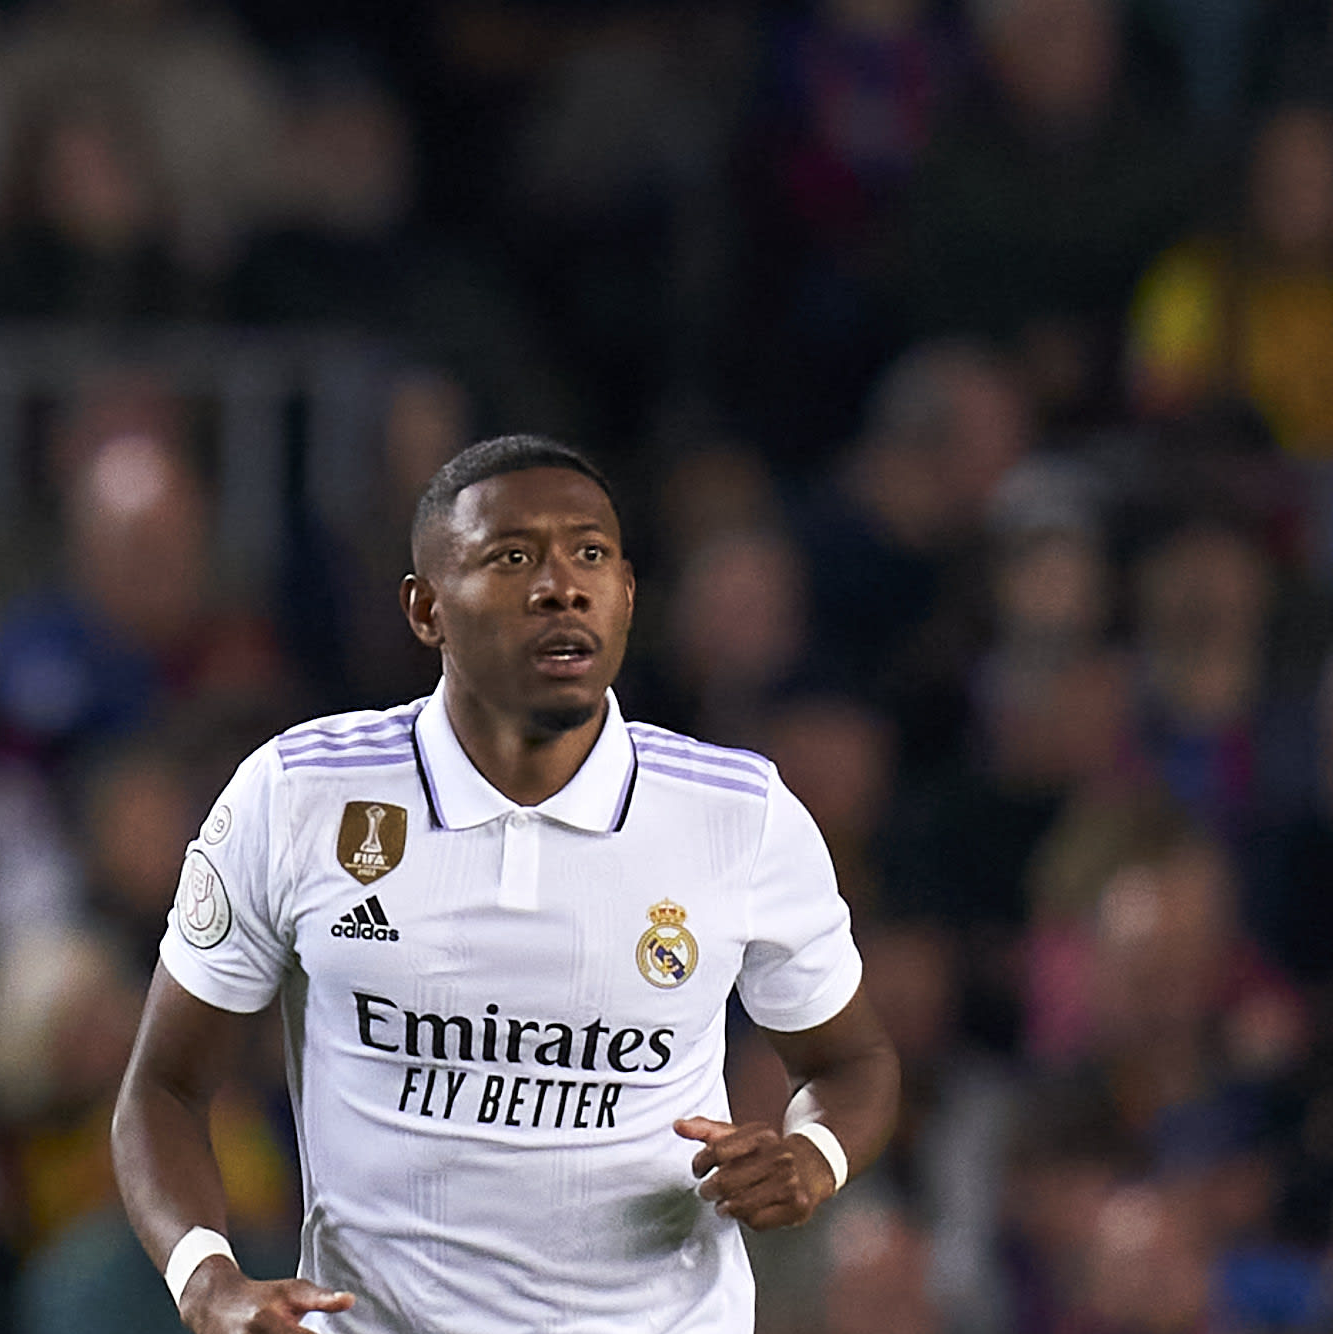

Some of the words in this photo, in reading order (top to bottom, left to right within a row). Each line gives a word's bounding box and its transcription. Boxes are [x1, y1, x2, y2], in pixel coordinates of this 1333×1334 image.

[353, 852, 386, 865] FIFA
[331, 922, 400, 941] adidas
[352, 991, 674, 1073] Emirates
[398, 1068, 467, 1120] FLY
[477, 1075, 623, 1129] BETTER
